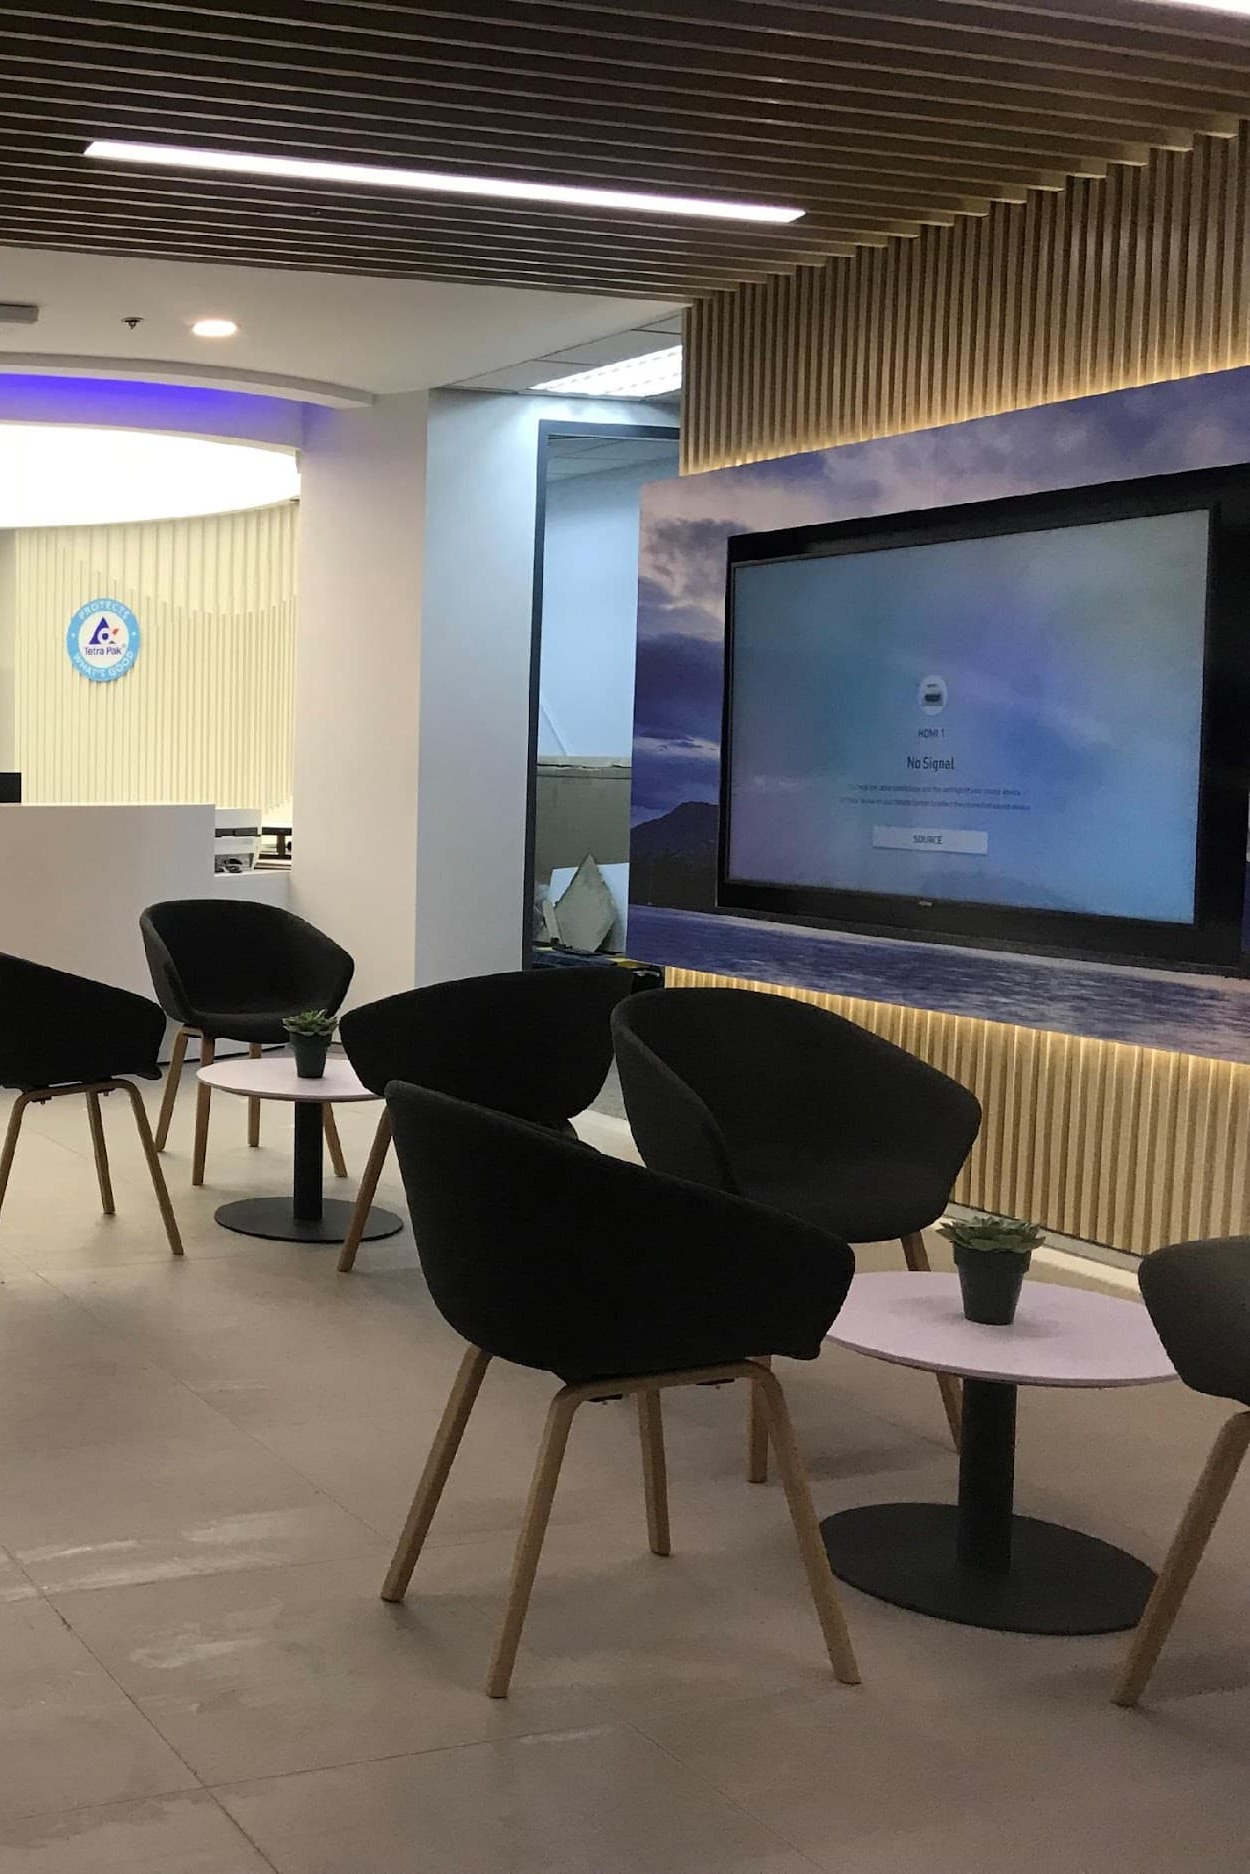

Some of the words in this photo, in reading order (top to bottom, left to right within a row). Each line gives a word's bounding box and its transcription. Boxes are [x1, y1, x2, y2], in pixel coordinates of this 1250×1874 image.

[78, 600, 131, 620] PROTECTS
[84, 646, 105, 656] Tetra
[106, 646, 122, 656] Pak
[73, 653, 105, 677] WHAT'S
[108, 651, 134, 676] GOOD
[918, 728, 939, 738] HDMI
[906, 756, 921, 769] No
[923, 756, 955, 772] Signal
[912, 834, 943, 846] SOURCE
